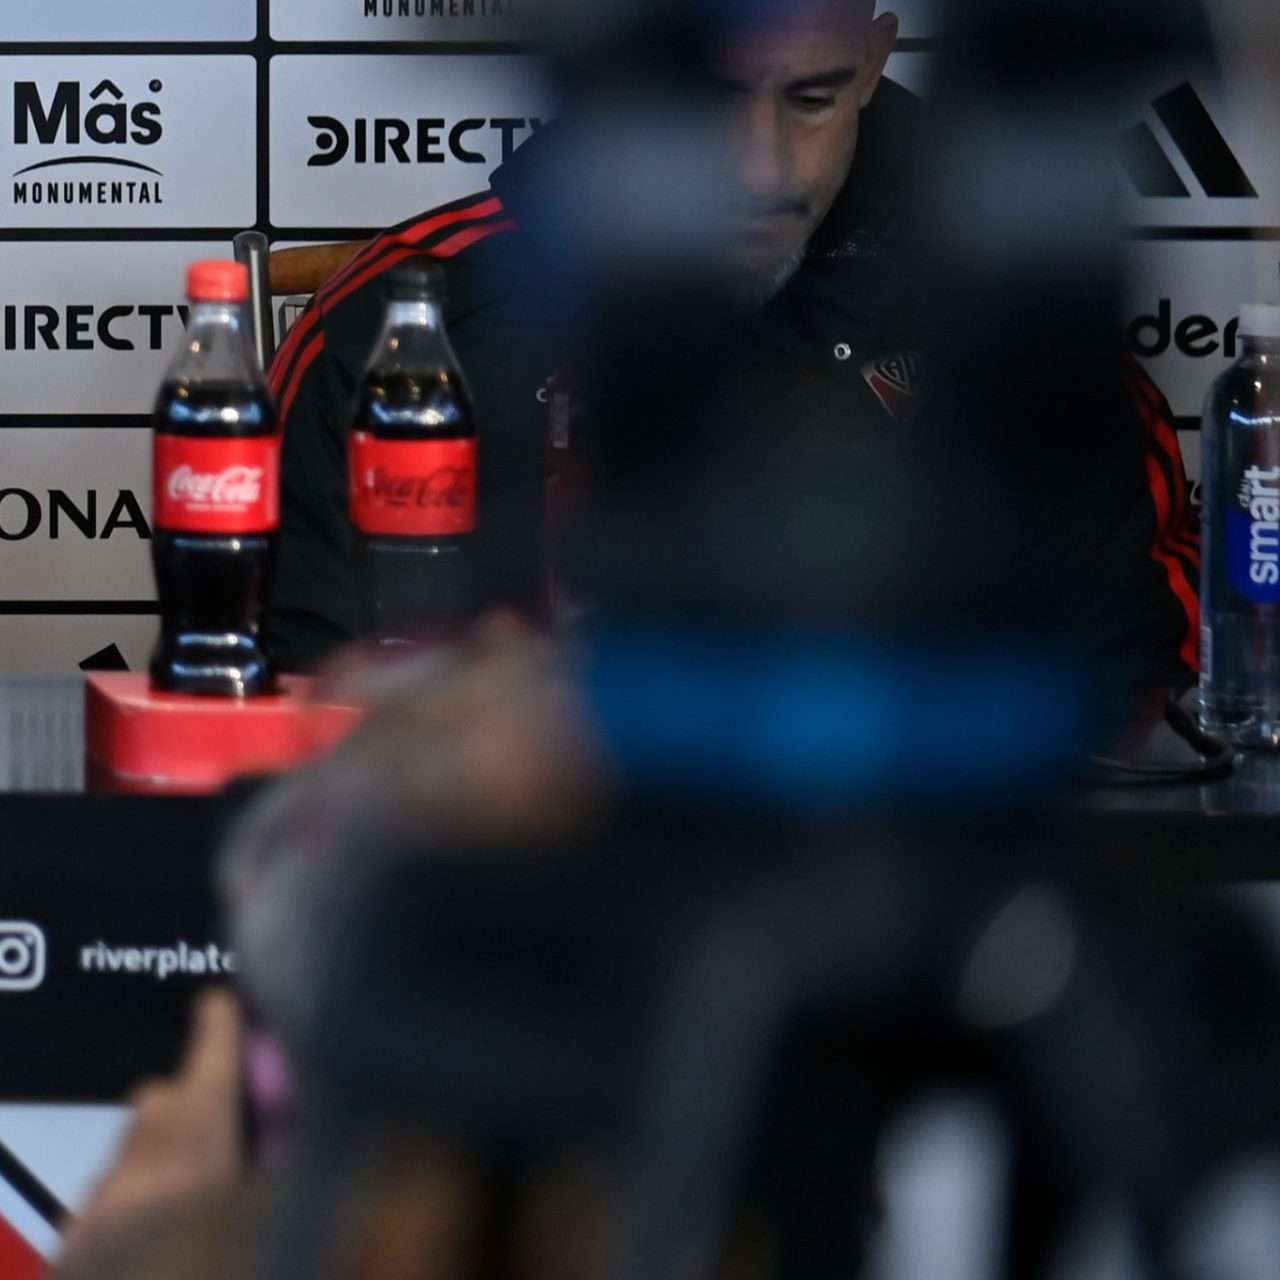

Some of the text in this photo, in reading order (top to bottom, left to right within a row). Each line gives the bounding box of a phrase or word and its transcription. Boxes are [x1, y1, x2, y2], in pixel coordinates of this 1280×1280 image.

[13, 78, 164, 145] Mâs
[306, 116, 552, 167] DIRECT
[12, 182, 164, 205] MONUMENTAL
[1244, 464, 1280, 585] smart
